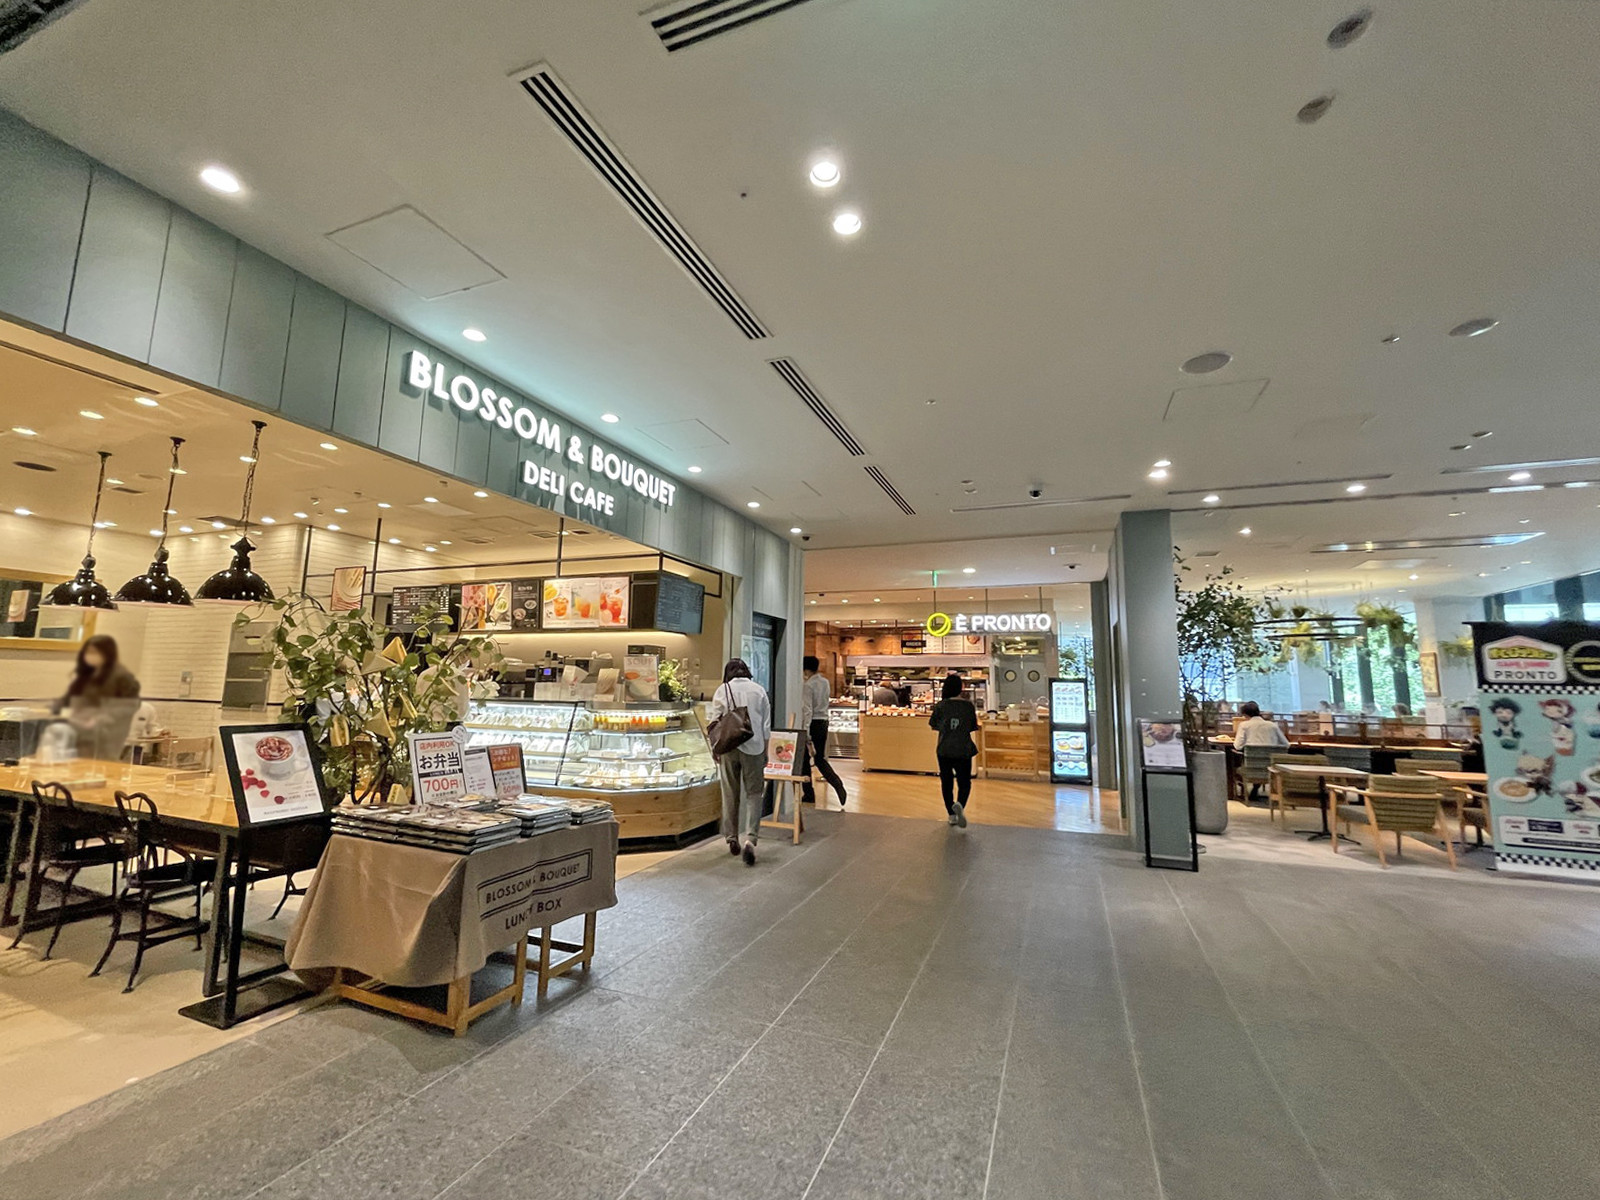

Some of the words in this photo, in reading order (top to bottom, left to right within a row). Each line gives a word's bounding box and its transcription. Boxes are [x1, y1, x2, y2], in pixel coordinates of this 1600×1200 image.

[408, 350, 561, 453] BLOSSOM
[567, 435, 585, 465] &
[590, 444, 676, 507] BOUQUET
[523, 459, 565, 496] DELI
[569, 481, 615, 516] CAFE
[955, 613, 967, 631] È
[971, 614, 1051, 631] PRONTO
[1494, 670, 1557, 680] PRONTO
[419, 752, 460, 770] お弁当
[423, 778, 459, 793] 700円
[537, 898, 562, 913] BOX
